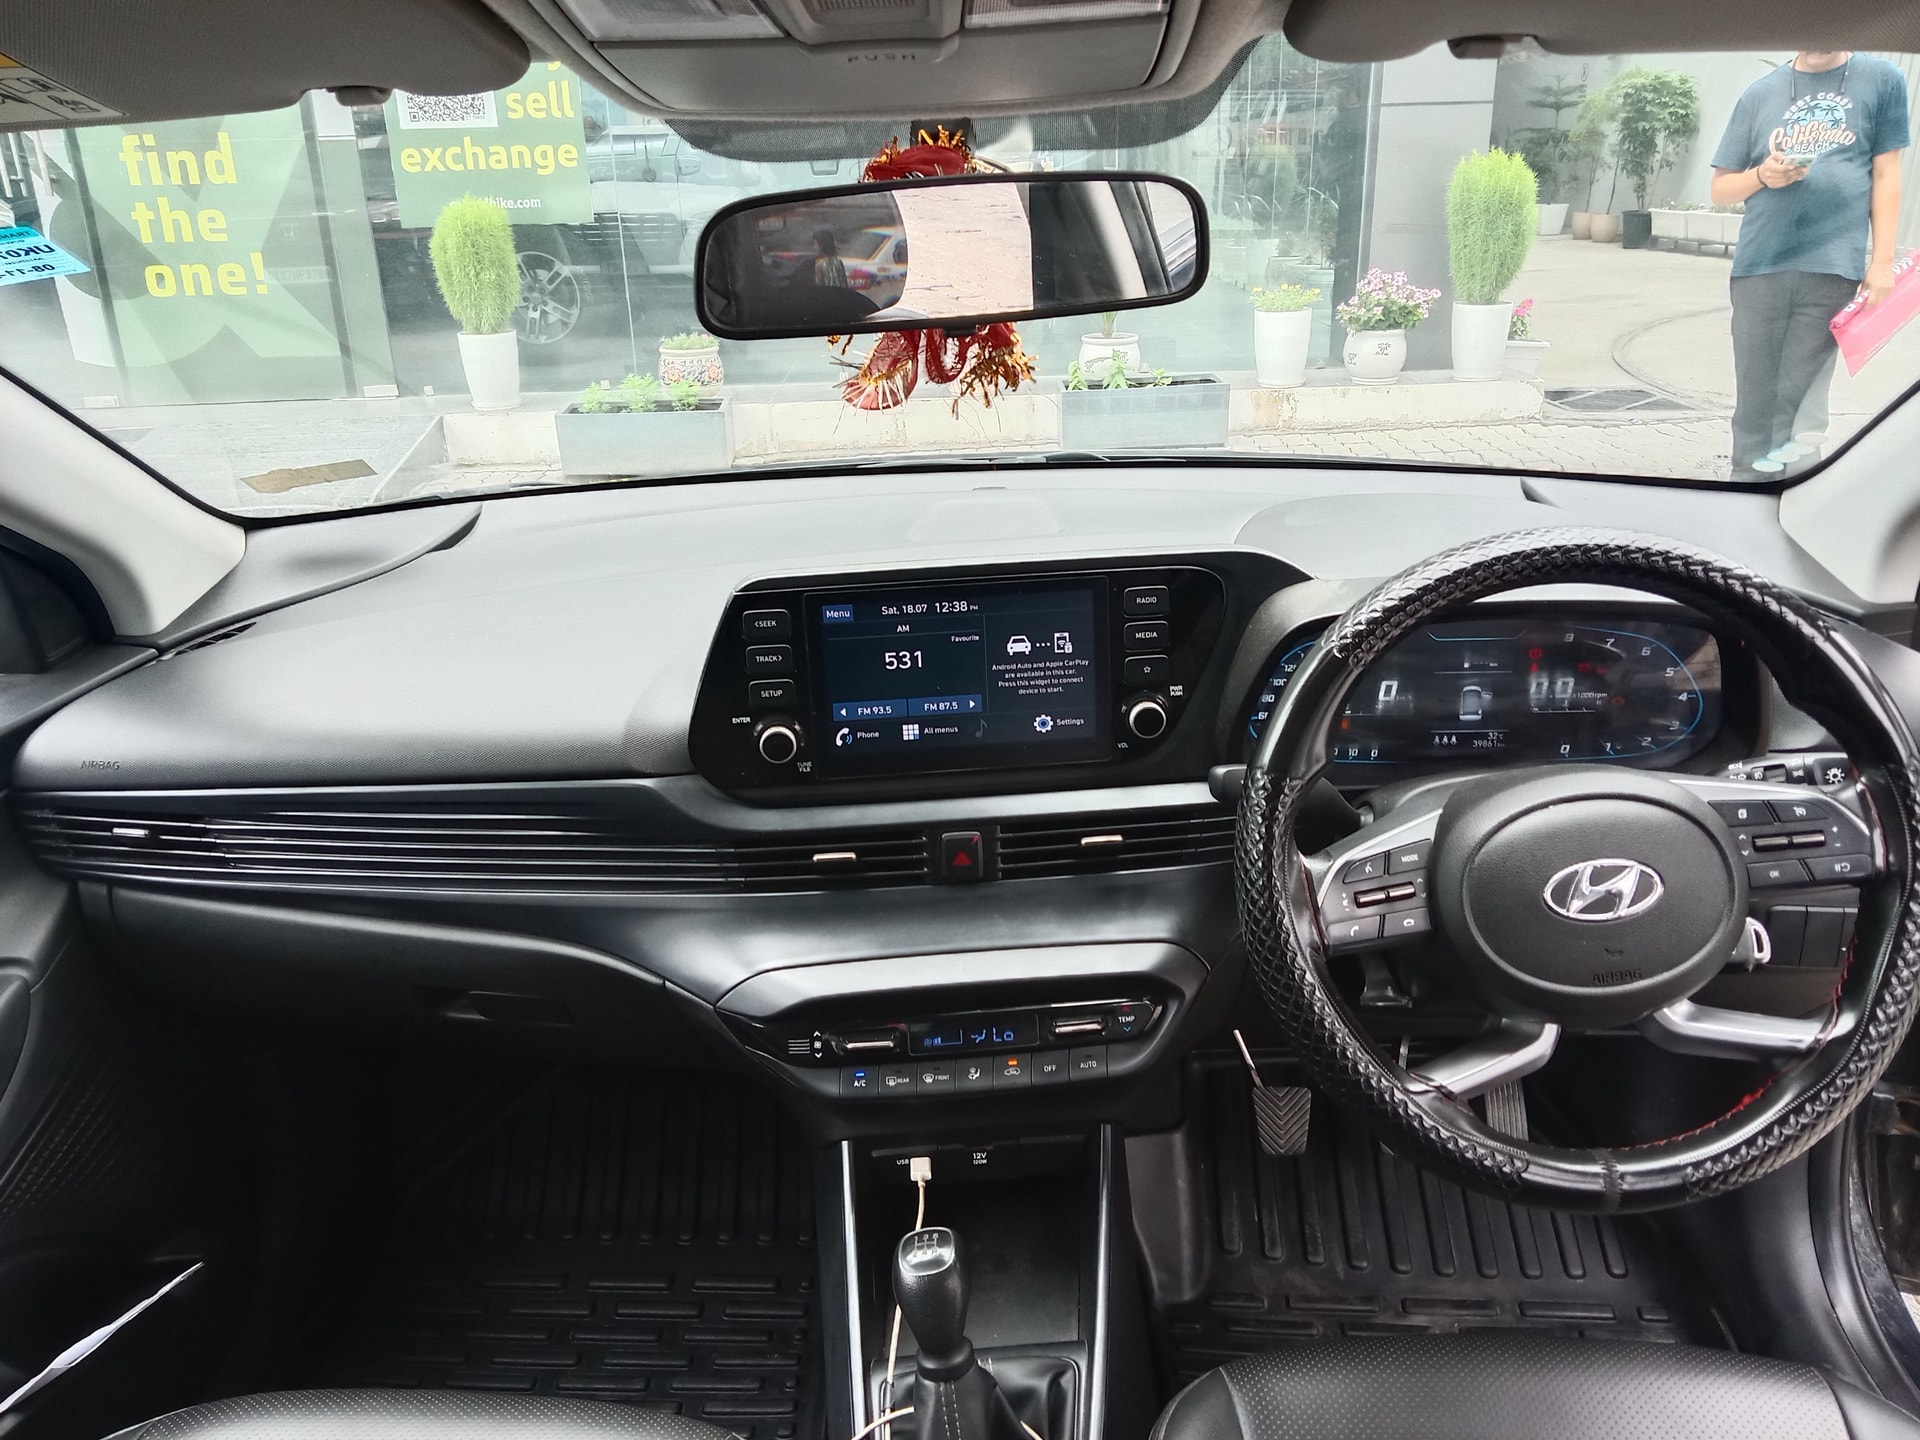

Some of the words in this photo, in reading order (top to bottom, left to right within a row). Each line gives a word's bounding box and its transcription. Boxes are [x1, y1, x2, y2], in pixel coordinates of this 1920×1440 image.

[506, 79, 575, 119] sell
[1817, 92, 1853, 110] COAST
[1769, 119, 1856, 155] California
[1794, 141, 1830, 152] BEACH
[118, 131, 238, 186] find
[400, 136, 579, 176] exchange
[449, 196, 542, 209] cabike.com
[131, 196, 229, 244] the
[144, 252, 269, 298] one!
[1136, 596, 1157, 604] RADIO
[902, 604, 928, 614] 18.07
[934, 601, 968, 613] 12:38
[826, 610, 851, 618] Menu
[897, 625, 910, 633] AM
[951, 634, 980, 643] Favourite
[1135, 631, 1158, 639] MEDIA
[1605, 638, 1616, 649] 7
[1641, 647, 1651, 656] 6
[884, 650, 923, 670] 531
[1046, 661, 1064, 669] Apple
[1664, 667, 1676, 677] 5
[1378, 680, 1398, 701] 0
[1678, 692, 1688, 702] 4
[857, 707, 871, 715] FM
[872, 706, 892, 715] 93.5
[924, 703, 937, 711] FM
[939, 702, 958, 710] 87.5
[1056, 718, 1084, 726] Settings
[1669, 721, 1680, 731] 3
[935, 726, 959, 734] menus
[857, 731, 879, 739] Phone
[1641, 737, 1652, 746] 2
[1371, 749, 1378, 757] 0
[1560, 744, 1570, 754] 0
[80, 760, 120, 770] AIRBAG
[1401, 854, 1419, 863] MODE
[1769, 870, 1780, 878] OK
[1591, 968, 1642, 985] AIRBAG
[1043, 1064, 1056, 1073] OFF
[1080, 1060, 1097, 1069] AUTO
[853, 1079, 866, 1087] A/C
